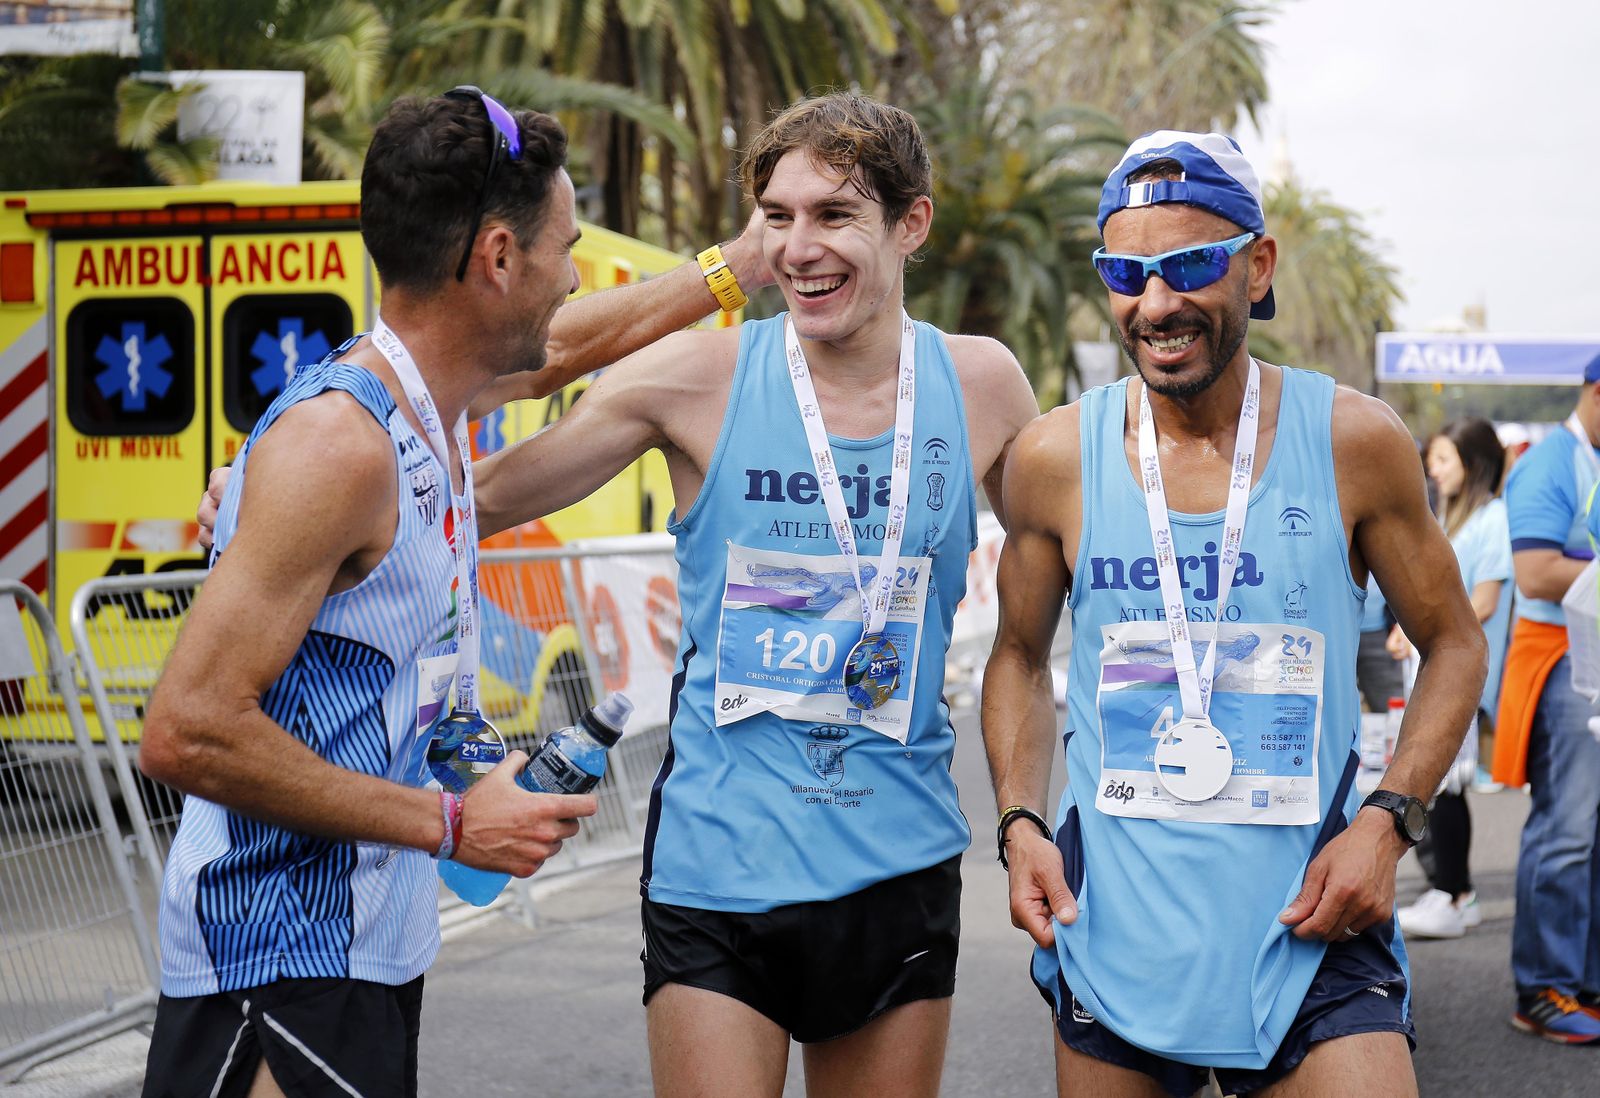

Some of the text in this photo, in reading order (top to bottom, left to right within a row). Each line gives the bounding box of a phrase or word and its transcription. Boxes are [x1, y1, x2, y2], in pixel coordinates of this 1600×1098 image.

[74, 241, 346, 288] AMBULANCIA
[1396, 343, 1505, 376] AGUA
[76, 438, 109, 459] UVI
[768, 519, 887, 540] ATLETMO
[1090, 541, 1264, 601] nerja
[1119, 604, 1242, 622] ATLEISMO
[755, 627, 836, 673] 120
[746, 671, 792, 684] CRISTOBAL
[1260, 743, 1306, 751] 663 587 141
[790, 785, 833, 795] Villanueva
[844, 786, 875, 798] Rosario
[805, 796, 822, 804] con
[824, 796, 832, 805] el
[1103, 781, 1135, 804] edp
